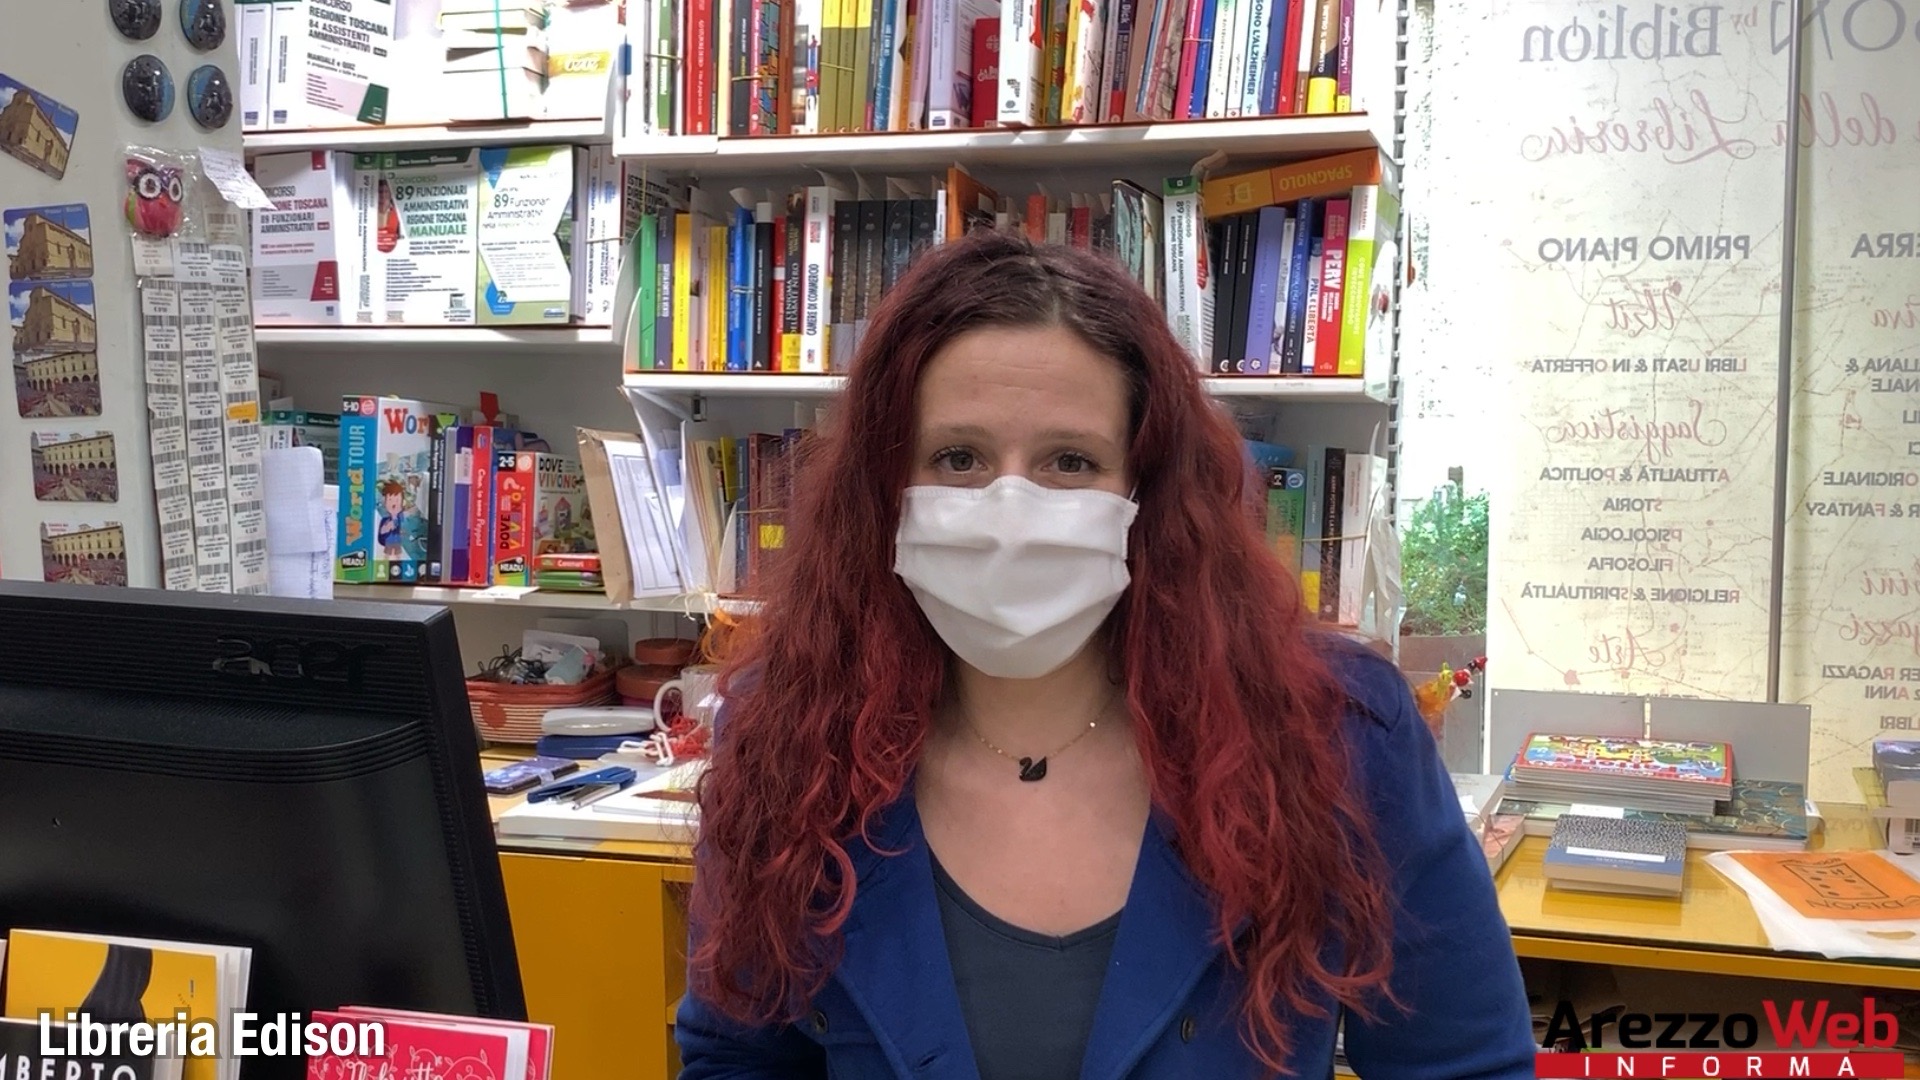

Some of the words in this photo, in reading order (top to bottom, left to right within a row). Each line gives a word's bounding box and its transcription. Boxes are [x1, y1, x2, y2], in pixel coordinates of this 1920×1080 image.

[310, 0, 352, 13] NCORSO
[1121, 3, 1131, 23] Dick
[309, 6, 347, 25] REGIONE
[349, 16, 389, 36] TOSCANA
[308, 29, 371, 53] AMMINISTRATIVI
[322, 22, 370, 43] ASSISTENTI
[1246, 29, 1262, 96] L'ALZHEIMER
[395, 175, 437, 185] CONCORSO
[1279, 164, 1353, 192] SPAGNOLO
[395, 185, 415, 201] 89
[416, 185, 467, 198] FUNZIONARI
[494, 193, 509, 208] 89
[294, 198, 328, 211] TOSCANA
[403, 199, 469, 213] AMMINISTRATIVI
[1176, 200, 1184, 213] 89
[271, 212, 315, 223] FUNZIONARI
[406, 213, 435, 225] REGIONE
[436, 212, 467, 223] TOSCANA
[260, 223, 315, 234] AMMINISTRATIVI
[408, 224, 467, 238] MANUALE
[1324, 249, 1343, 289] PERV
[806, 264, 819, 303] COMMERCIO
[1178, 258, 1186, 313] AMMINISTRATIVI
[1310, 278, 1320, 296] PNL
[806, 310, 819, 336] CAMERE
[348, 425, 366, 466] TOUR
[499, 456, 515, 468] 2-5
[539, 457, 563, 473] DOVE
[477, 468, 486, 490] Ciao,
[346, 467, 366, 546] World
[475, 518, 486, 547] Peppa!
[499, 514, 511, 550] DOVE
[342, 556, 365, 567] HEADU
[500, 563, 524, 572] HEADU
[211, 634, 386, 686] acer
